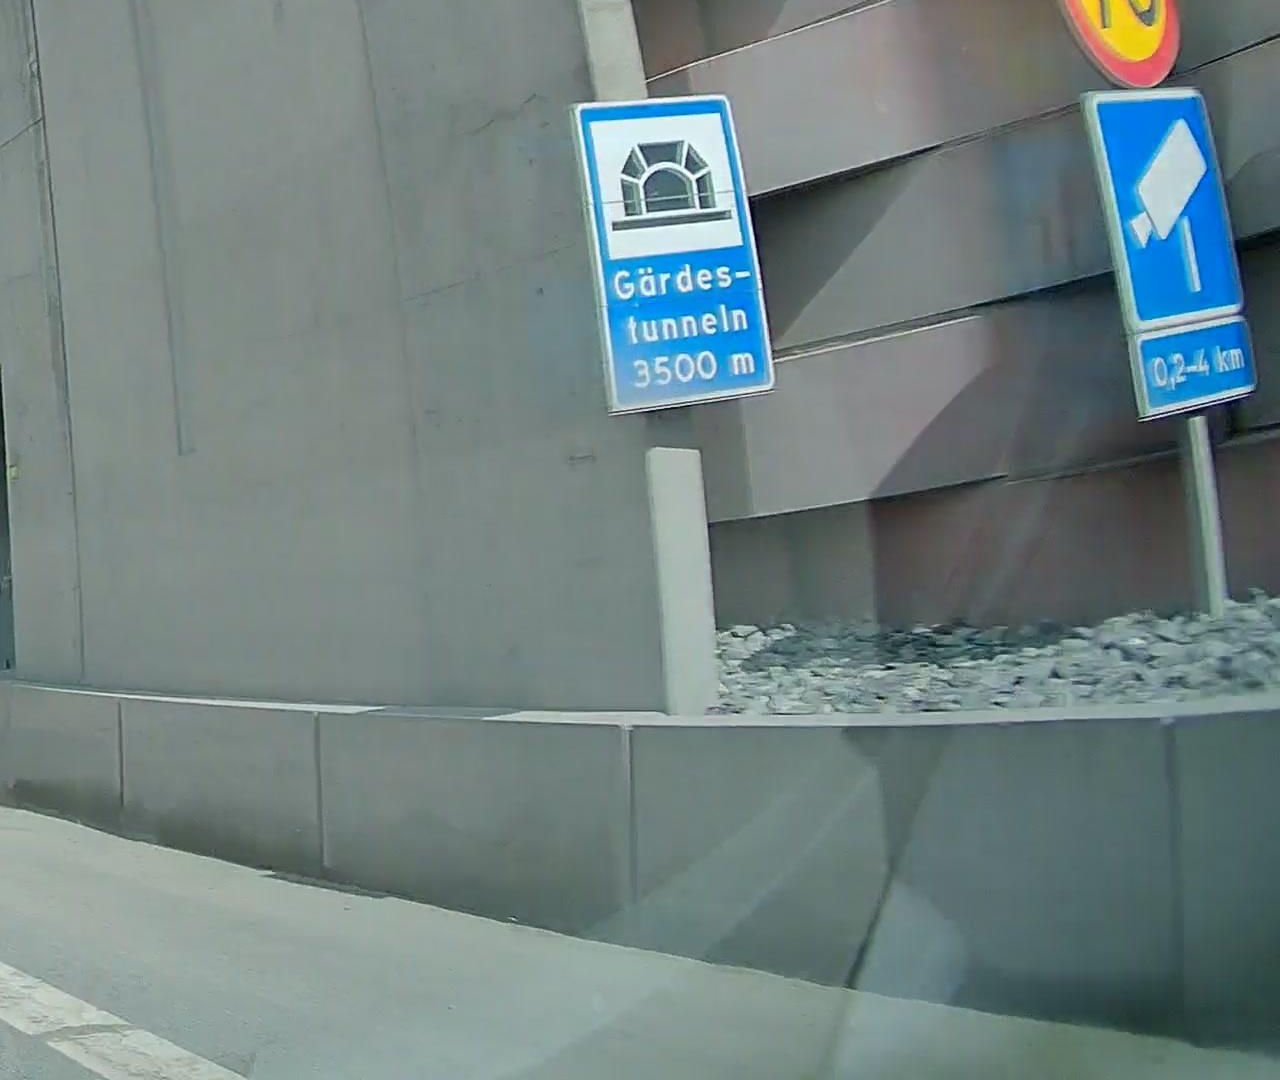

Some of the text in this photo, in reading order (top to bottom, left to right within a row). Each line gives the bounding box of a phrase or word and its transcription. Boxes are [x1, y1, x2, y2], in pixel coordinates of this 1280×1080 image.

[613, 264, 752, 300] Gärdes-
[627, 304, 749, 344] tunneln
[633, 350, 755, 388] 3500 m
[1151, 346, 1245, 391] 0,2-4 km
